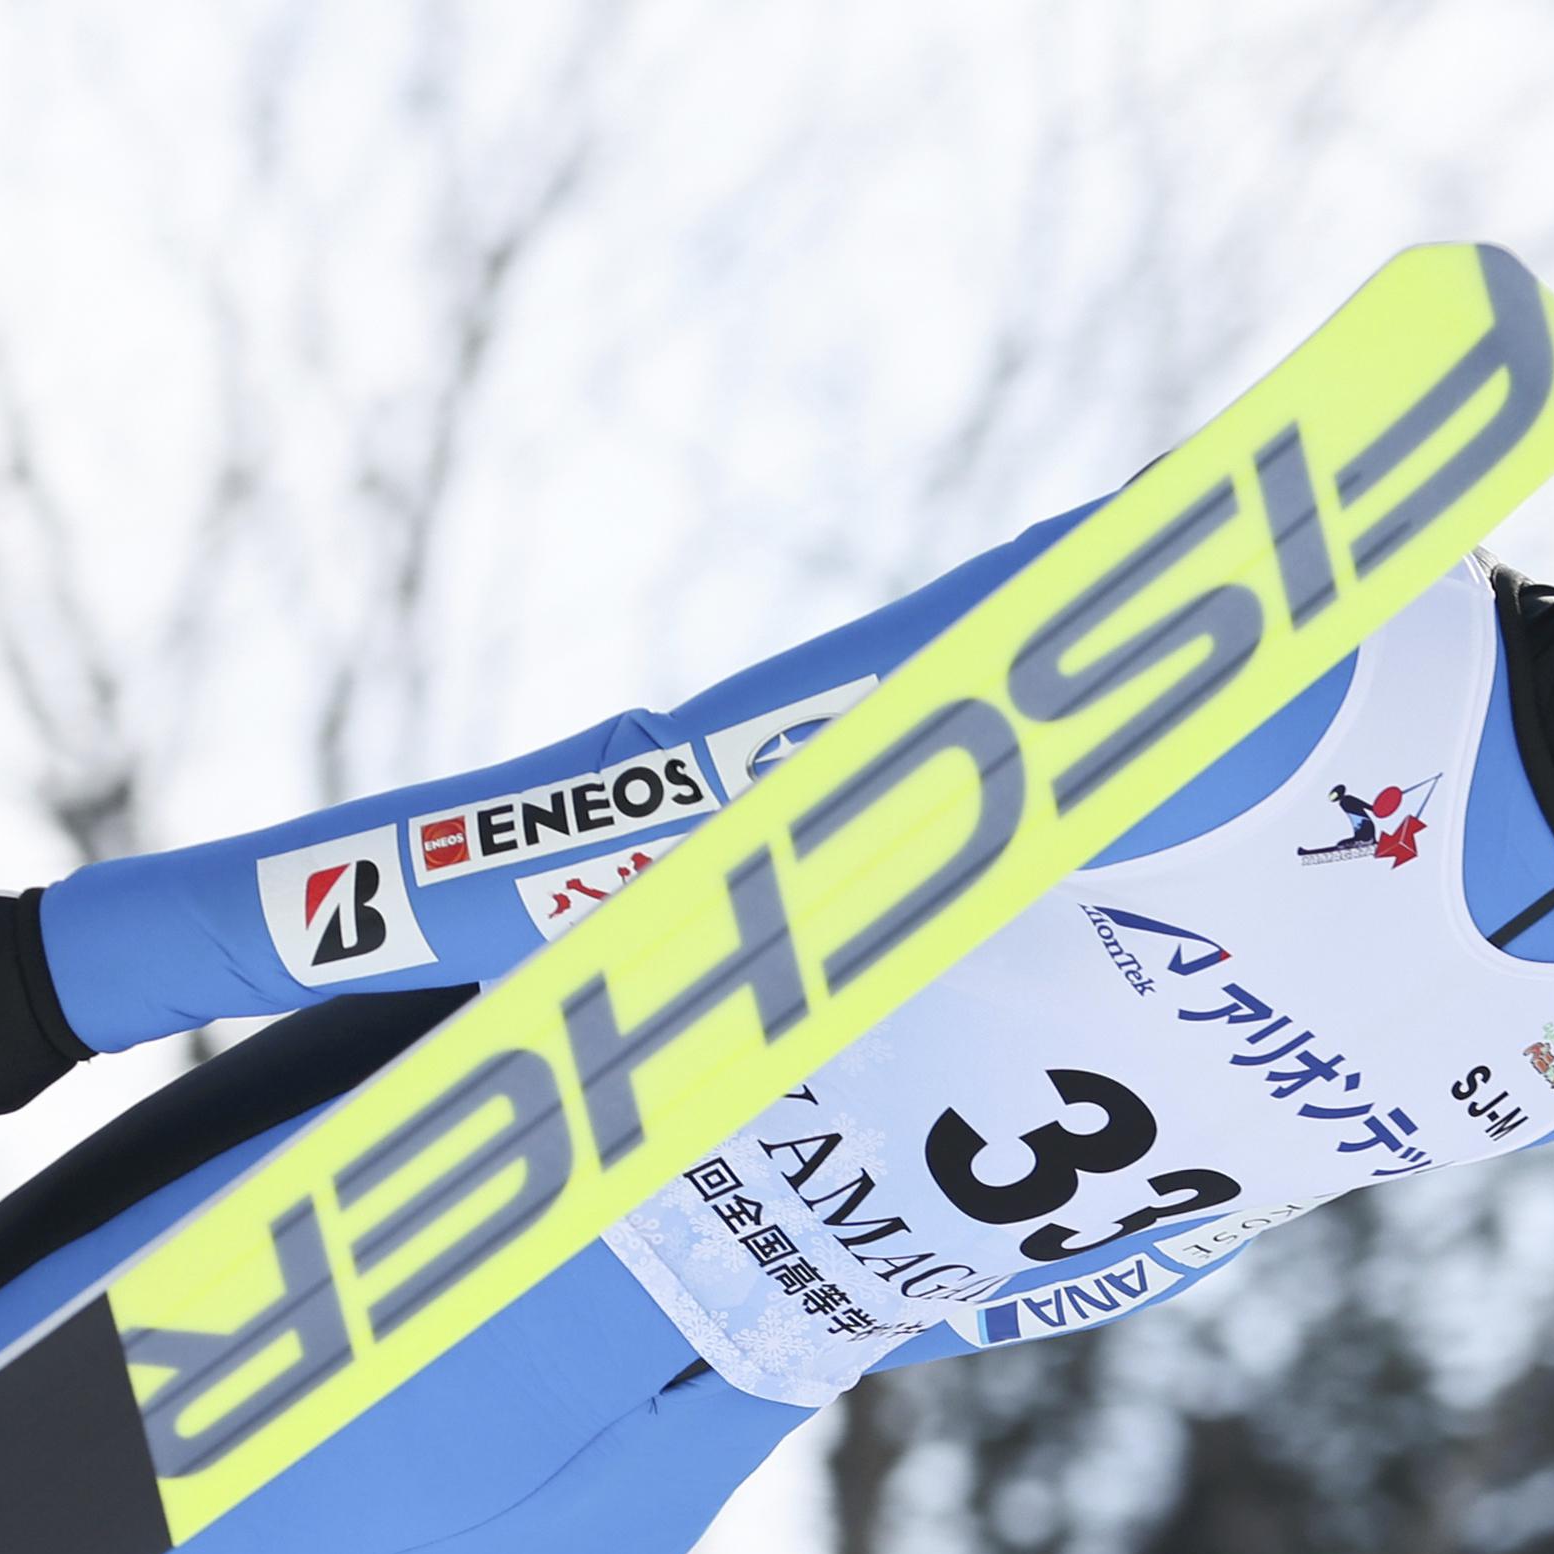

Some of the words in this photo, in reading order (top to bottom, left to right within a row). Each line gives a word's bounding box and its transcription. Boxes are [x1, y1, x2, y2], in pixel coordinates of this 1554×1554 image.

[424, 831, 465, 853] ENEOS
[476, 758, 704, 857] ENEOS
[121, 243, 1554, 1479] FISCHER
[925, 1068, 1242, 1262] 33
[1021, 1259, 1150, 1328] ANA
